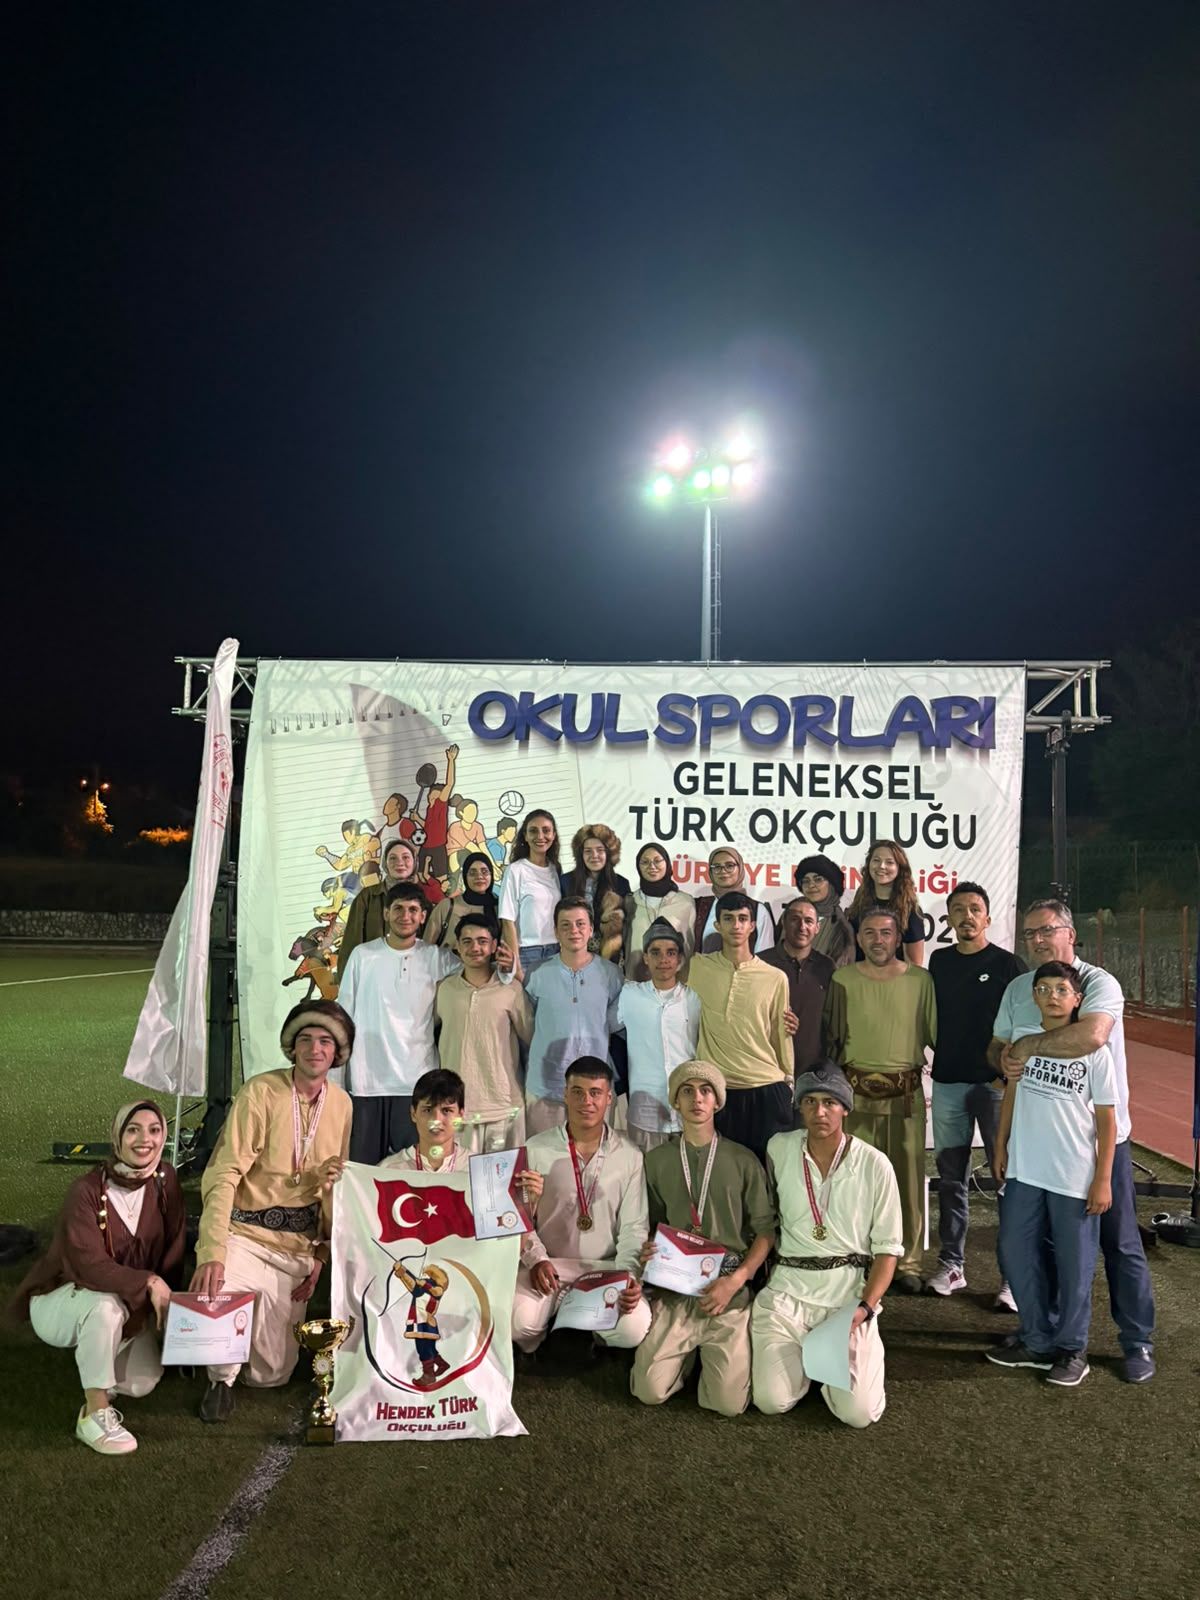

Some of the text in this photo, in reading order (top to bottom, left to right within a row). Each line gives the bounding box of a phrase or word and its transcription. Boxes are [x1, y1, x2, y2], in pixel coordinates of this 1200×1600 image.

[468, 690, 996, 749] OKUL SPORLARI
[673, 761, 935, 801] GELENEKSEL
[629, 799, 977, 852] TÜRK OKÇULUĞU
[672, 853, 781, 887] ÜRYE
[1034, 1057, 1067, 1075] BEST
[438, 1395, 479, 1416] TÜRK
[387, 1421, 467, 1433] OKÇULUĞU
